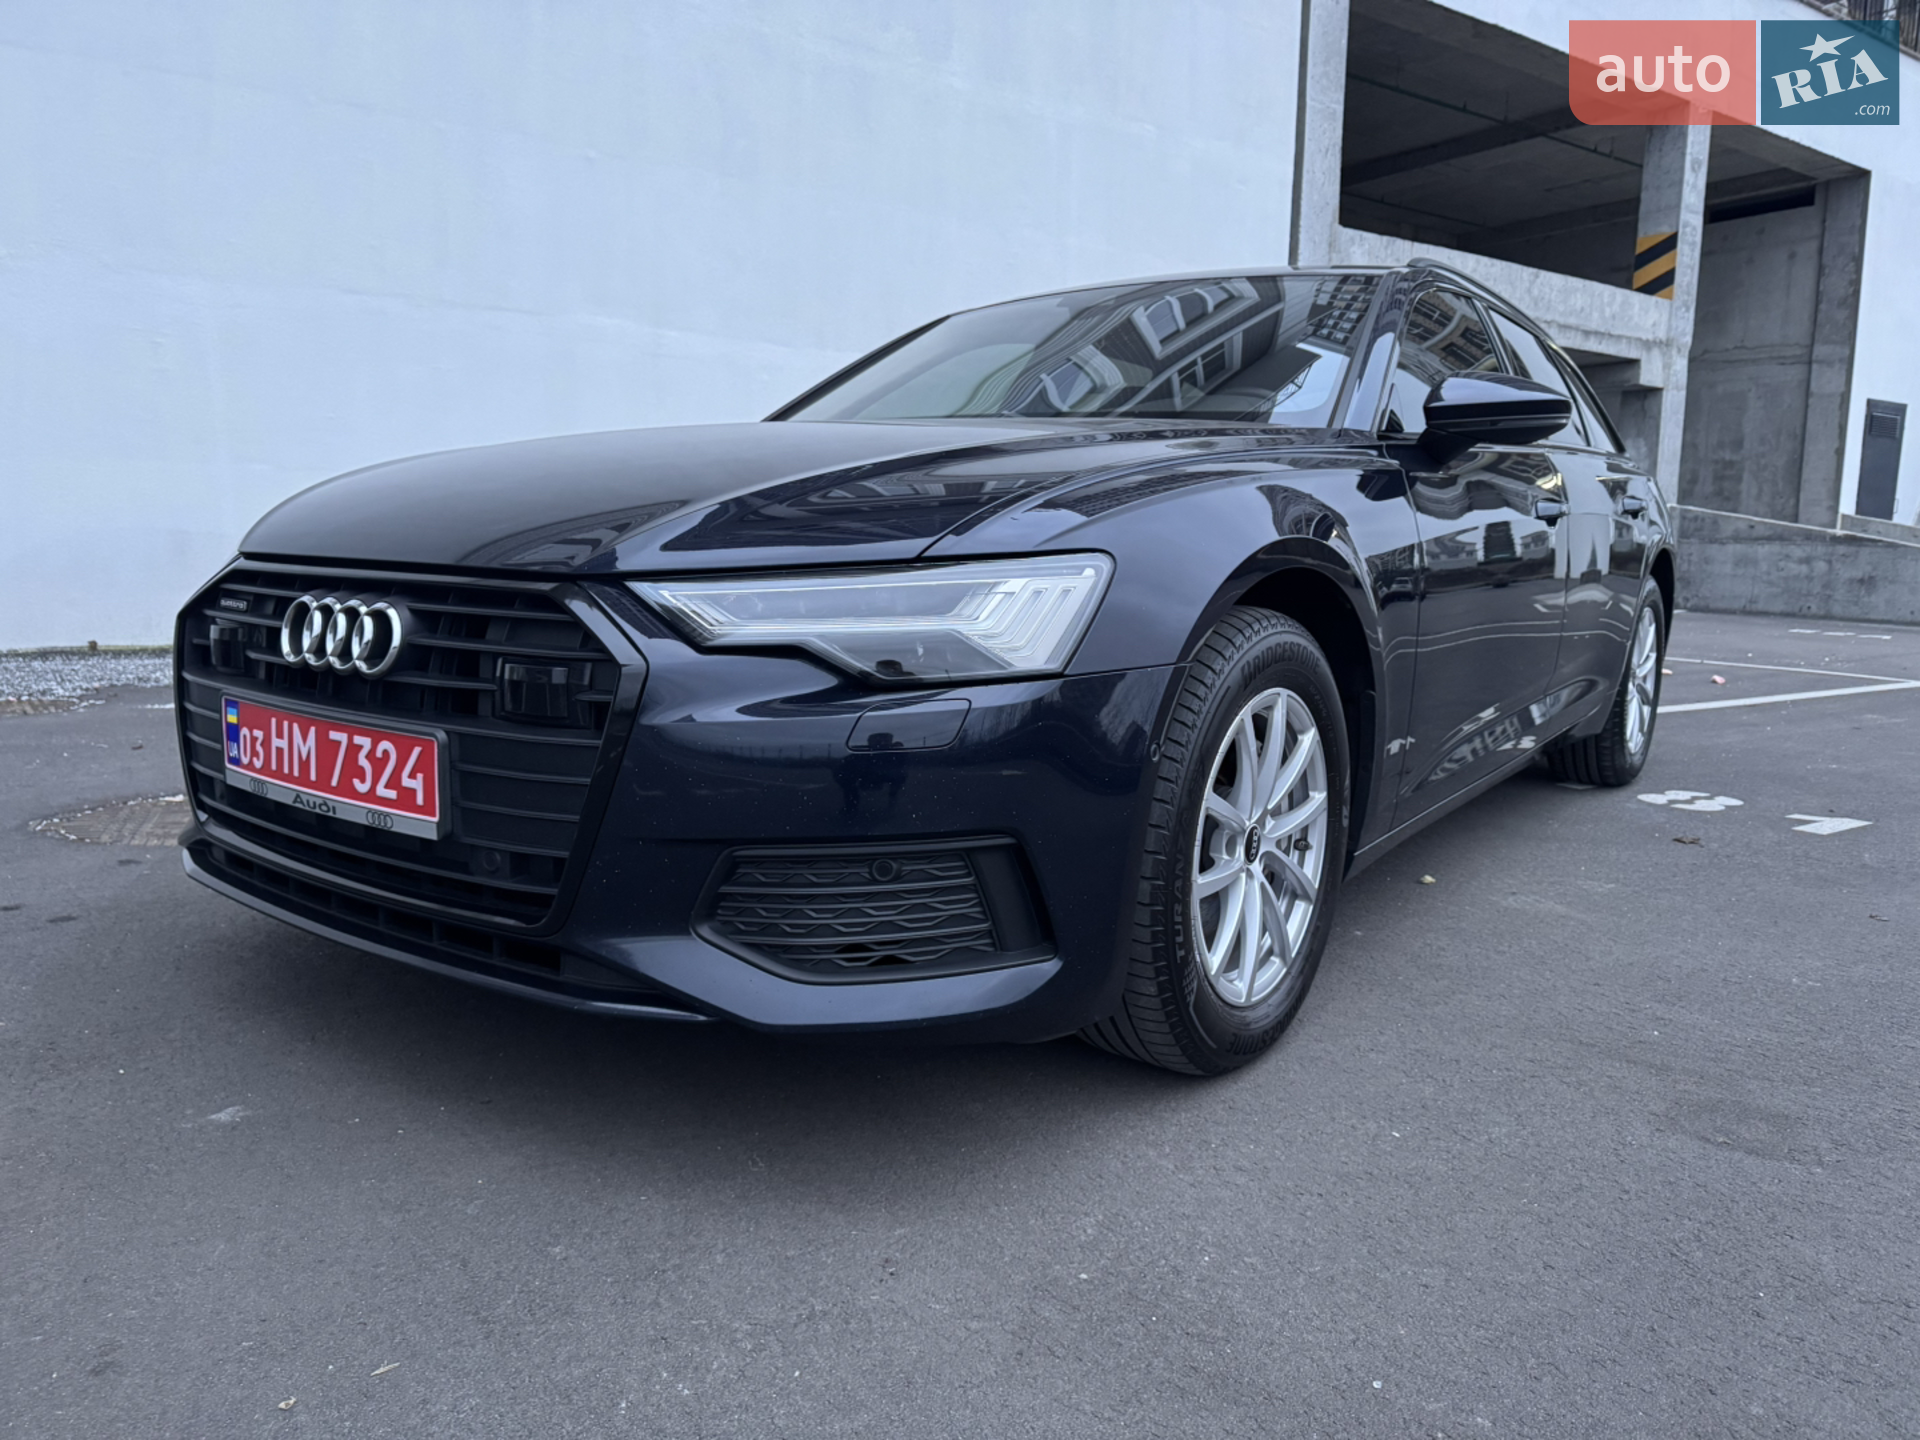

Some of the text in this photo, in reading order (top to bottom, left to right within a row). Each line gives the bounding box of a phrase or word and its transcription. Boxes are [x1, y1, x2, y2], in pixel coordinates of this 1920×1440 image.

[1241, 641, 1321, 691] BRIDGESTONE
[228, 741, 239, 759] UA
[329, 730, 424, 806] 7324
[292, 792, 337, 816] Audi
